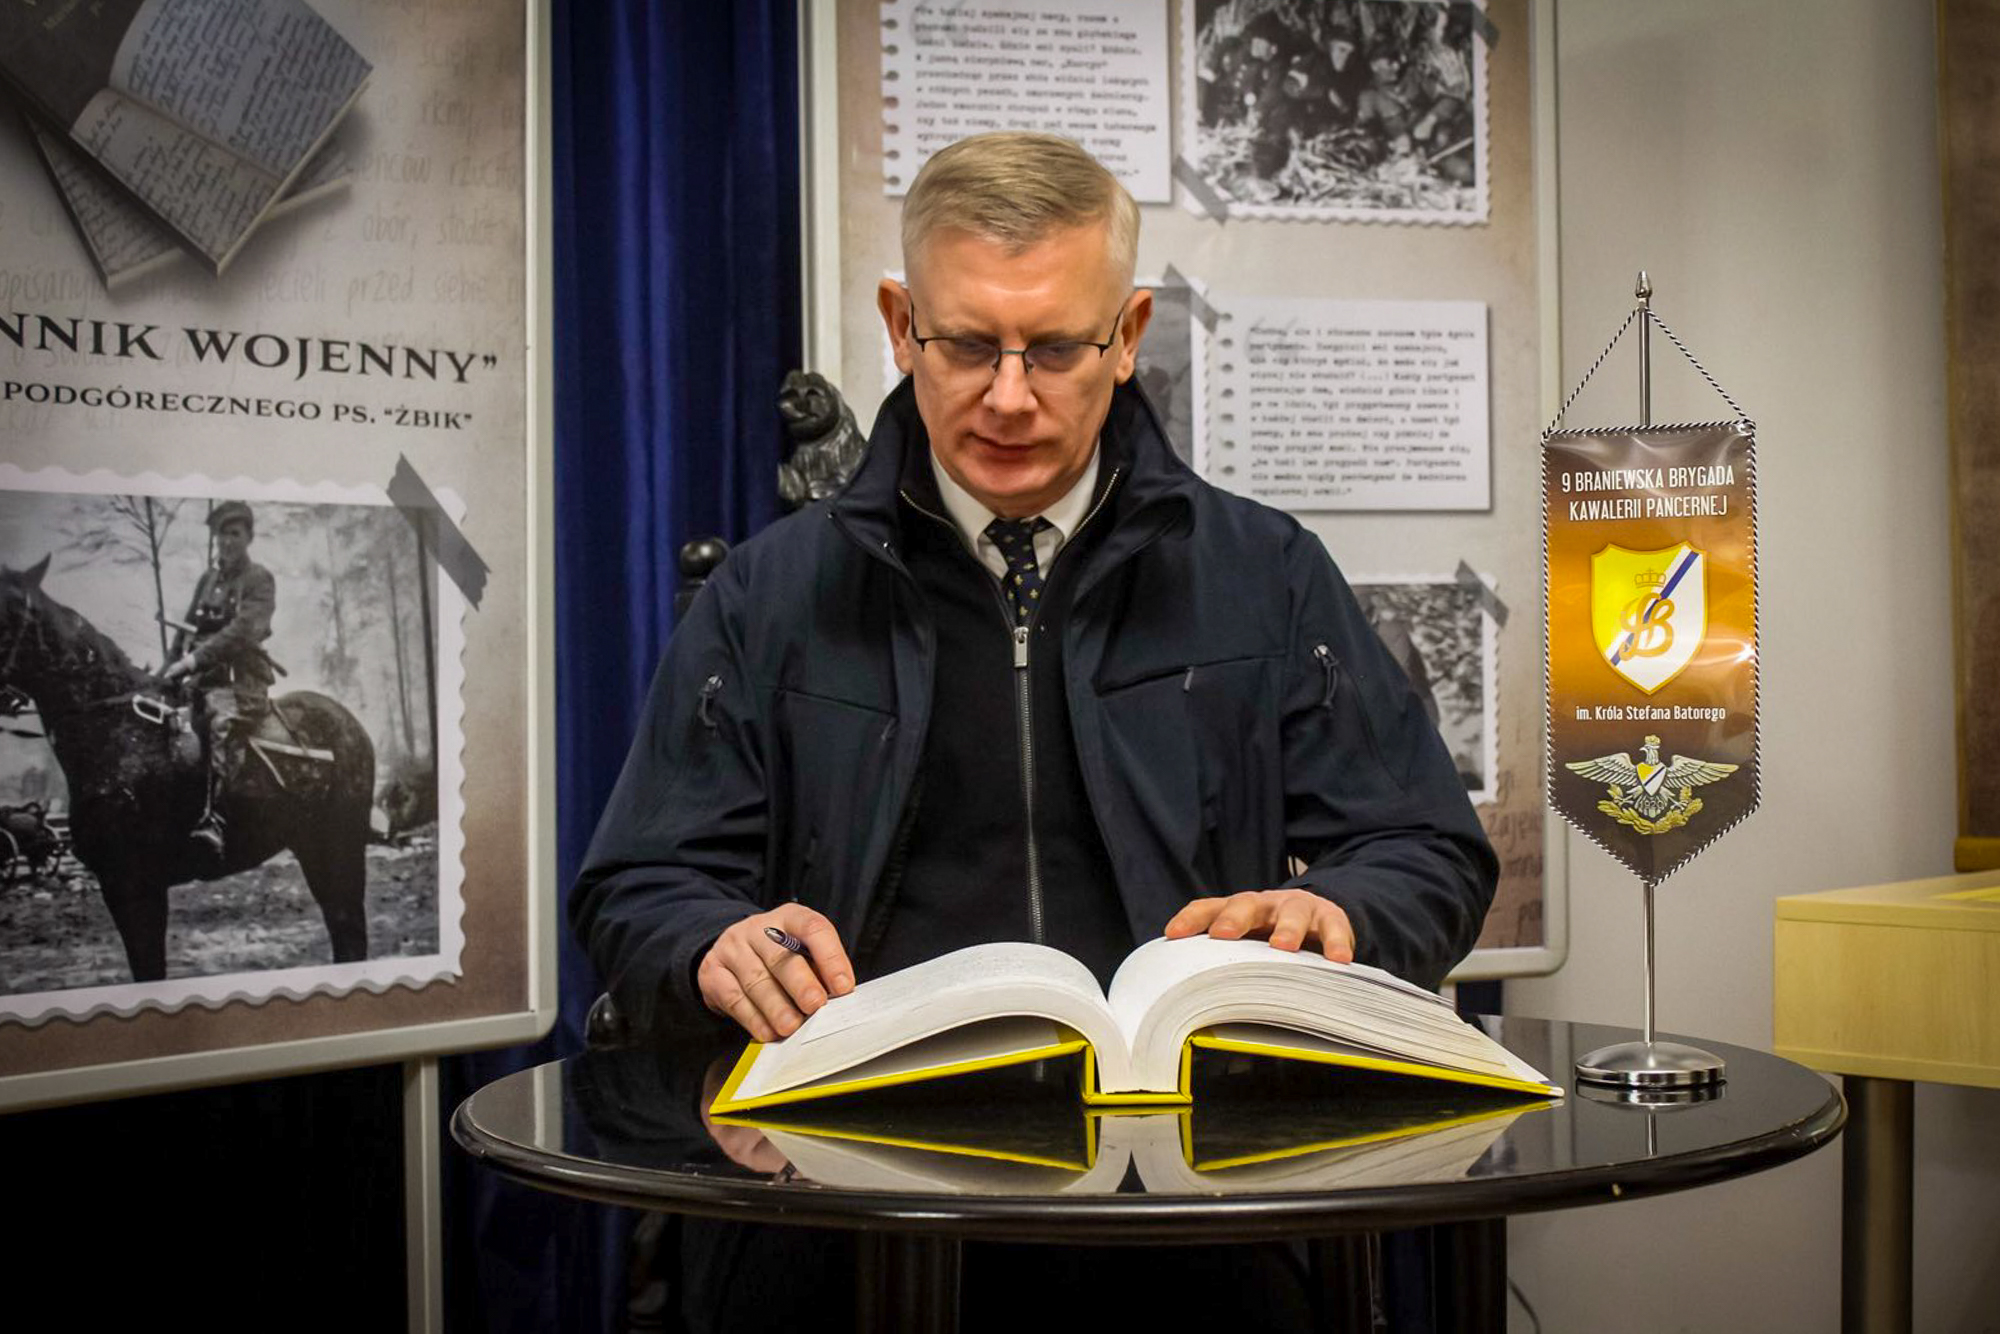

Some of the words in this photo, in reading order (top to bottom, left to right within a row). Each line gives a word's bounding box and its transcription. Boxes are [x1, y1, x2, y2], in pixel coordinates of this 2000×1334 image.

[4, 381, 321, 420] PODGÓRECZNEGO
[333, 404, 376, 424] PS.
[1562, 472, 1571, 493] 9
[1575, 468, 1664, 492] BRANIEWSKA
[1669, 465, 1735, 488] BRYGADA
[1569, 499, 1642, 521] KAWALERII
[1646, 495, 1728, 518] PANCERNEJ
[1576, 706, 1593, 720] im.
[1595, 705, 1623, 720] Króla
[1626, 705, 1671, 720] Stefana
[1673, 705, 1726, 722] Batorego
